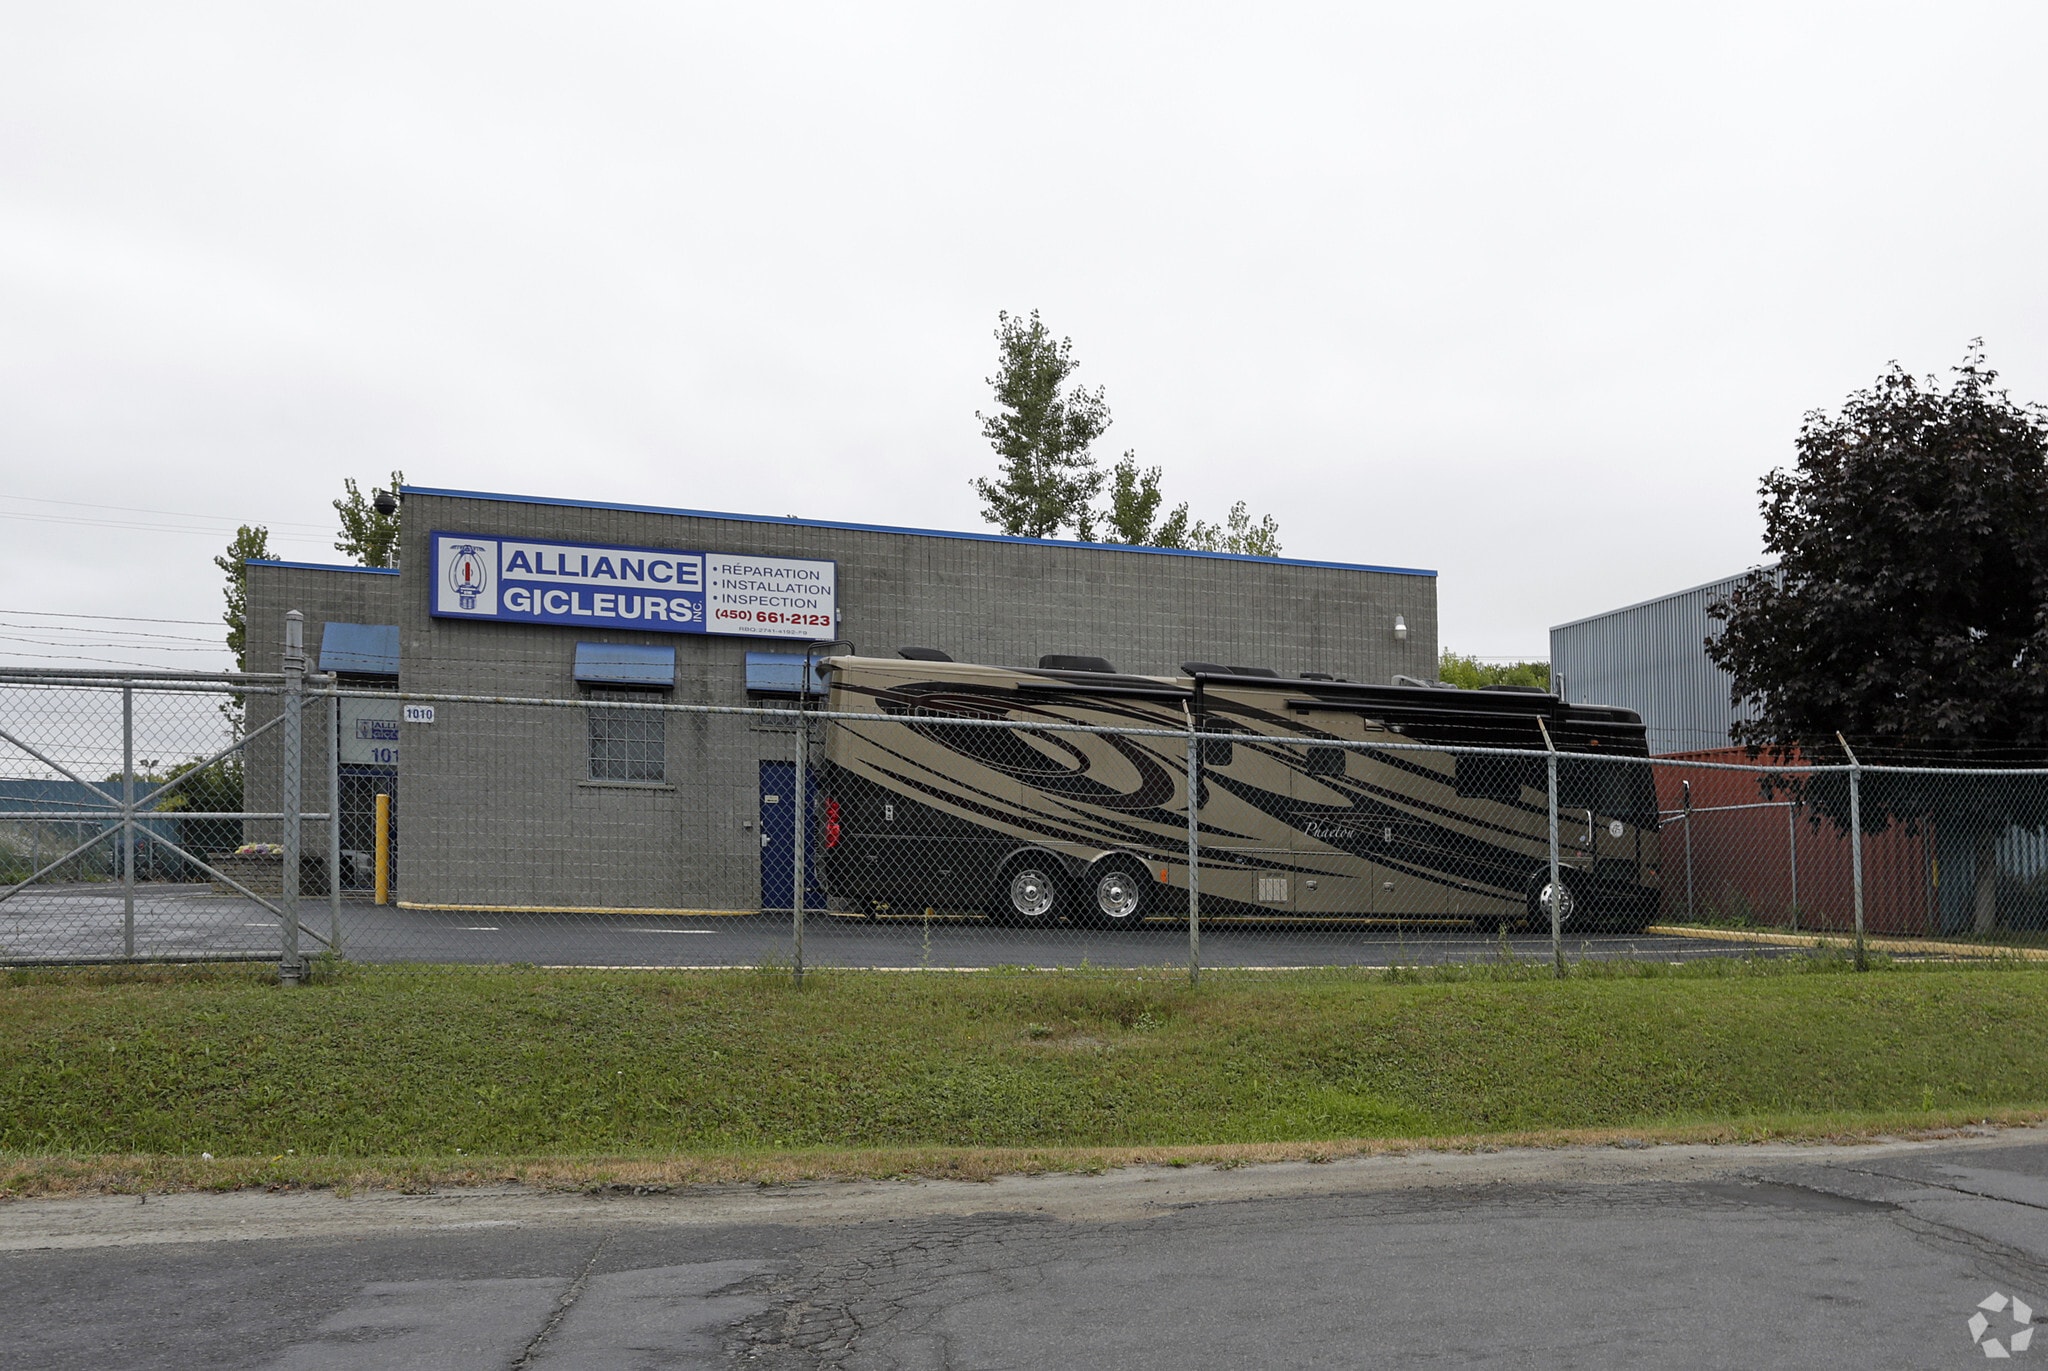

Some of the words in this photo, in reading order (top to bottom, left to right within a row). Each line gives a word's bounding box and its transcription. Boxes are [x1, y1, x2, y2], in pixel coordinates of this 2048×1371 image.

[505, 550, 699, 585] ALLIANCE
[722, 563, 820, 580] RÉPARATION
[722, 579, 831, 595] INSTALLATION
[503, 587, 693, 622] GICLEURS
[693, 600, 702, 622] INC.
[722, 594, 817, 609] INSPECTION
[715, 608, 752, 621] (450)
[756, 611, 830, 626] 661-2123
[406, 708, 433, 720] 1010
